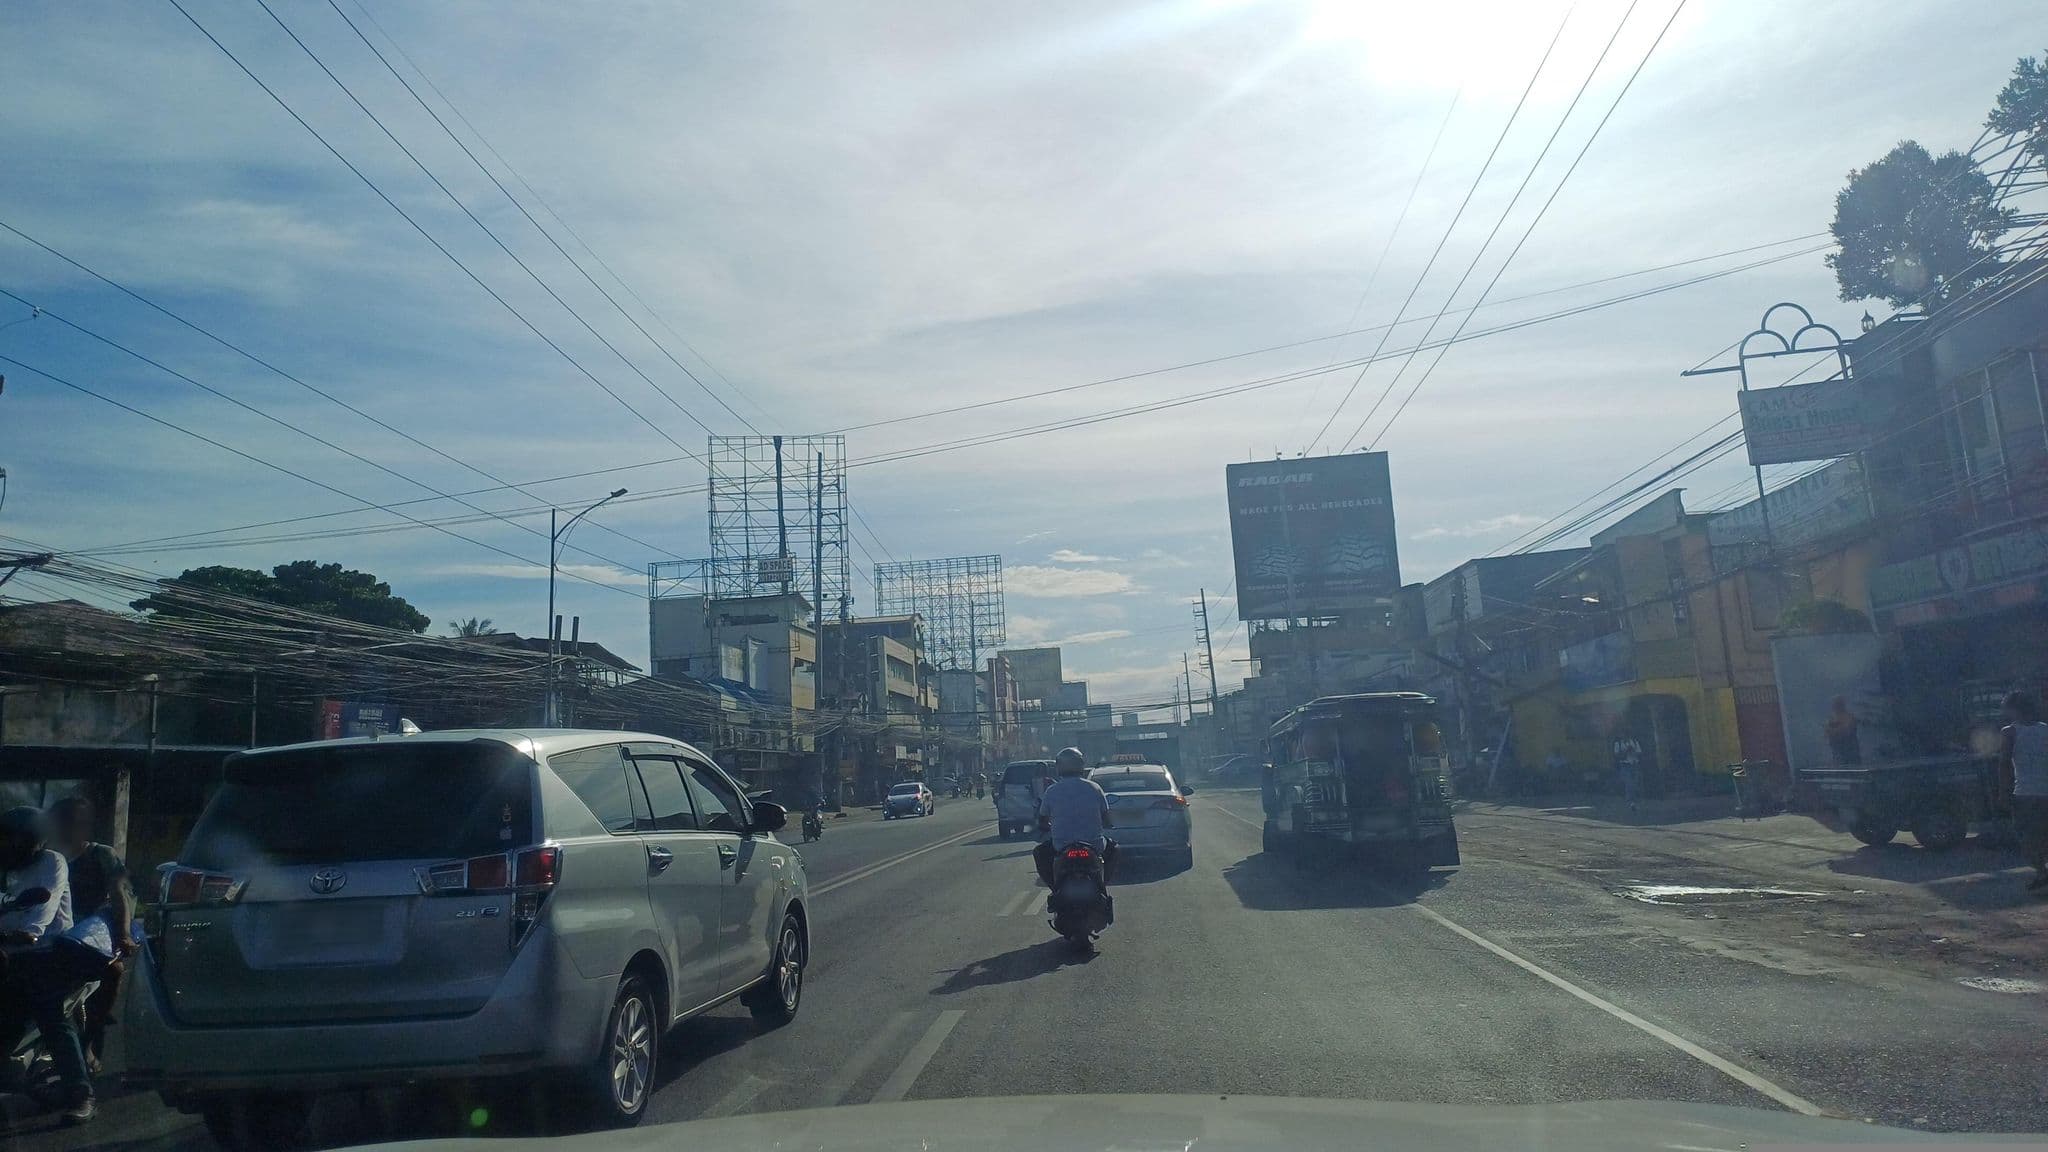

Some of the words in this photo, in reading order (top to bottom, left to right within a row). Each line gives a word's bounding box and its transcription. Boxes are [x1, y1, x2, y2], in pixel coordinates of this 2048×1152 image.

[1238, 472, 1313, 488] RADAR
[1240, 506, 1269, 516] MADE
[1298, 502, 1318, 512] ALL
[769, 558, 792, 571] SPACE
